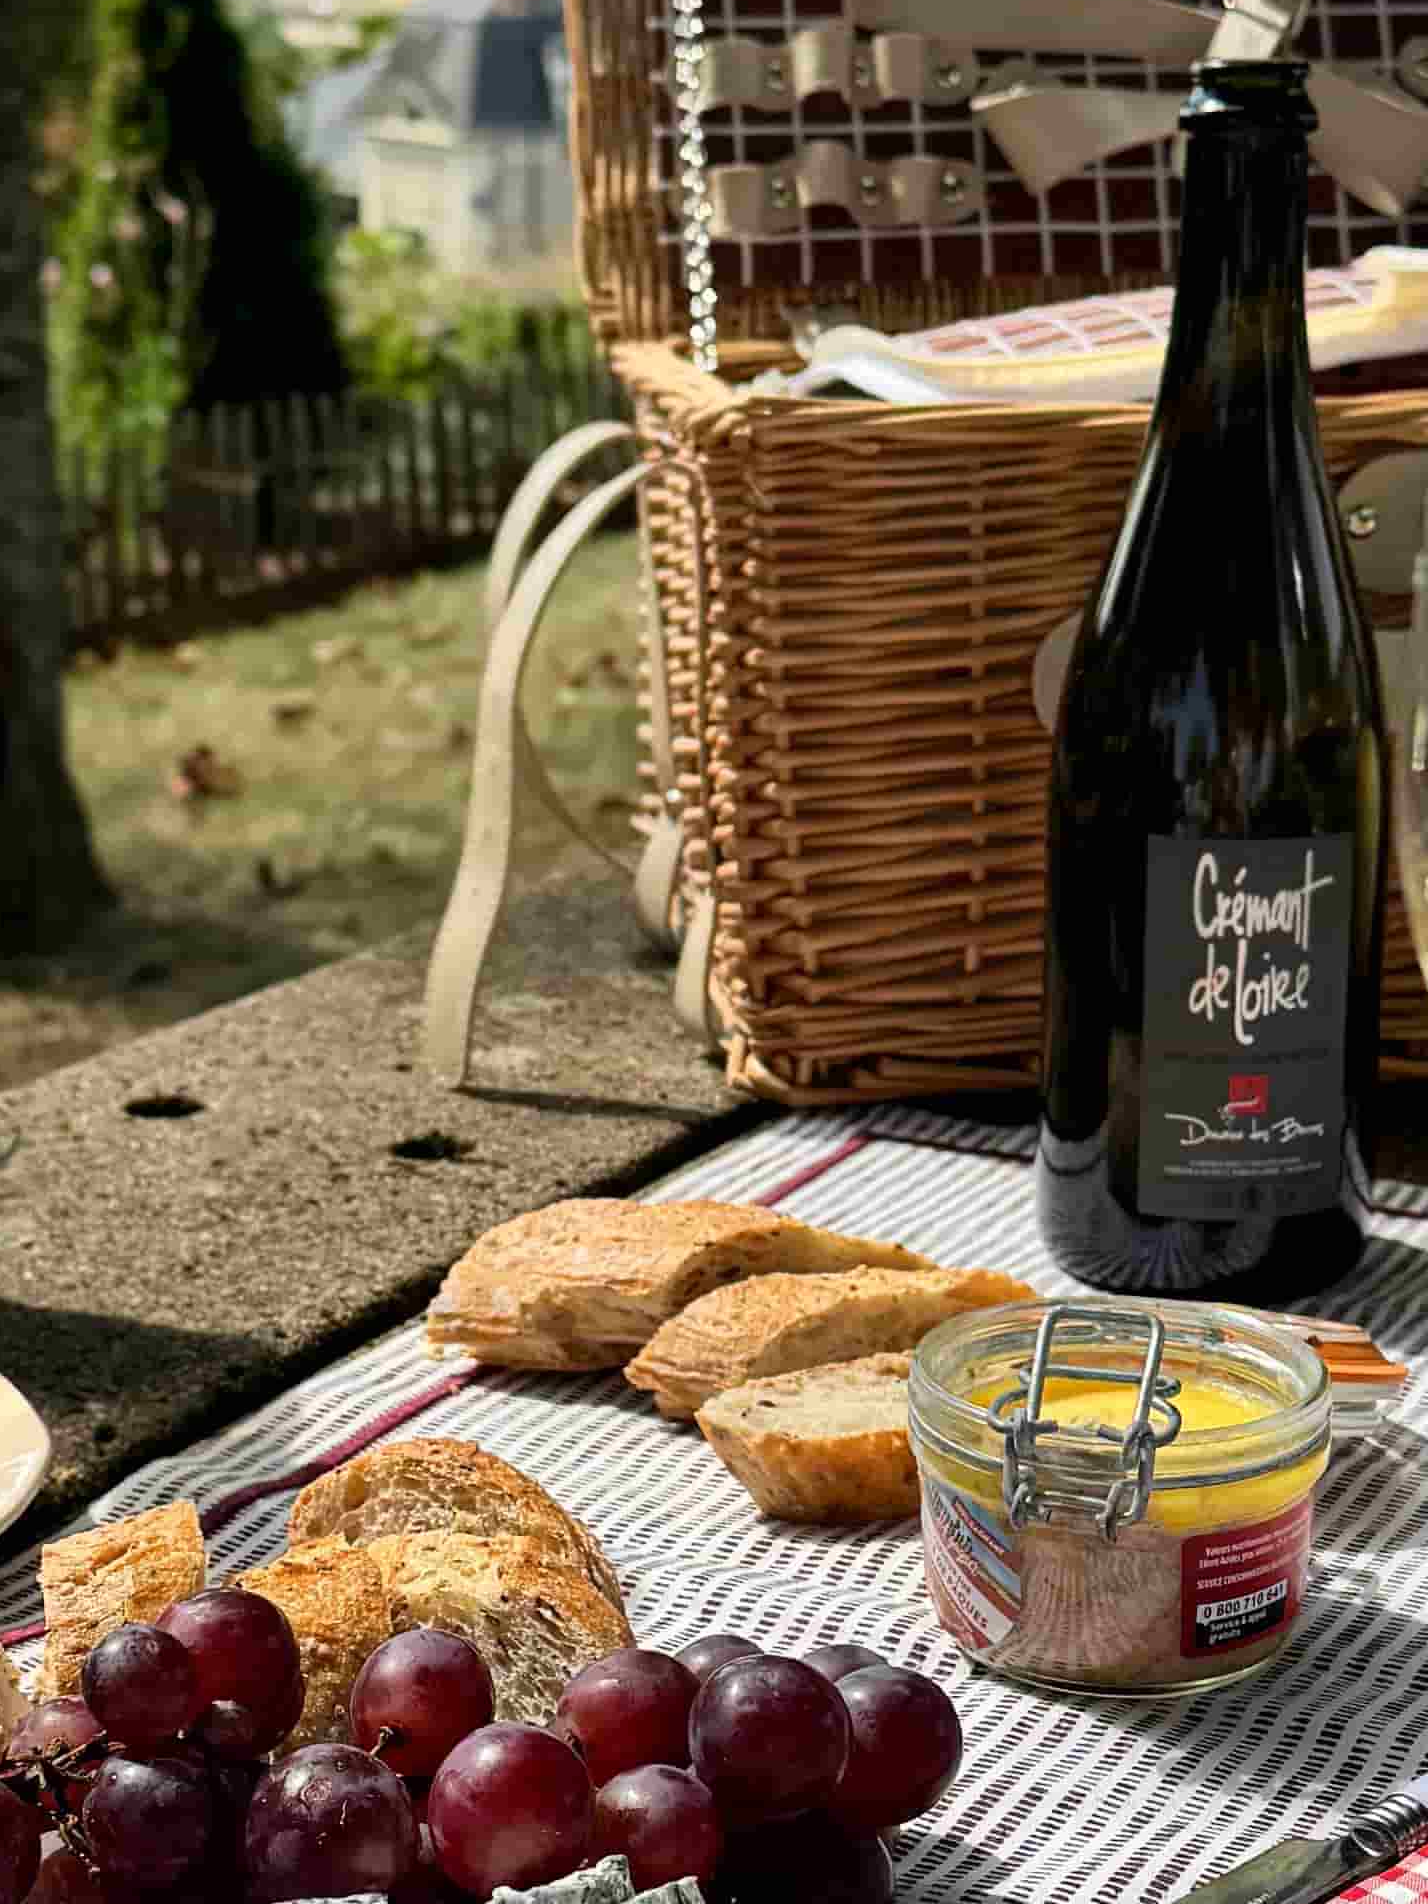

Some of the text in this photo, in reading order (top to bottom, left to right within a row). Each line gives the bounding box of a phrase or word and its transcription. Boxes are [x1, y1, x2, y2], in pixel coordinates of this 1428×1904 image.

[1193, 850, 1334, 951] Crémant
[1188, 937, 1310, 1046] de Loire
[1203, 1606, 1212, 1618] 0
[1216, 1600, 1241, 1617] 800
